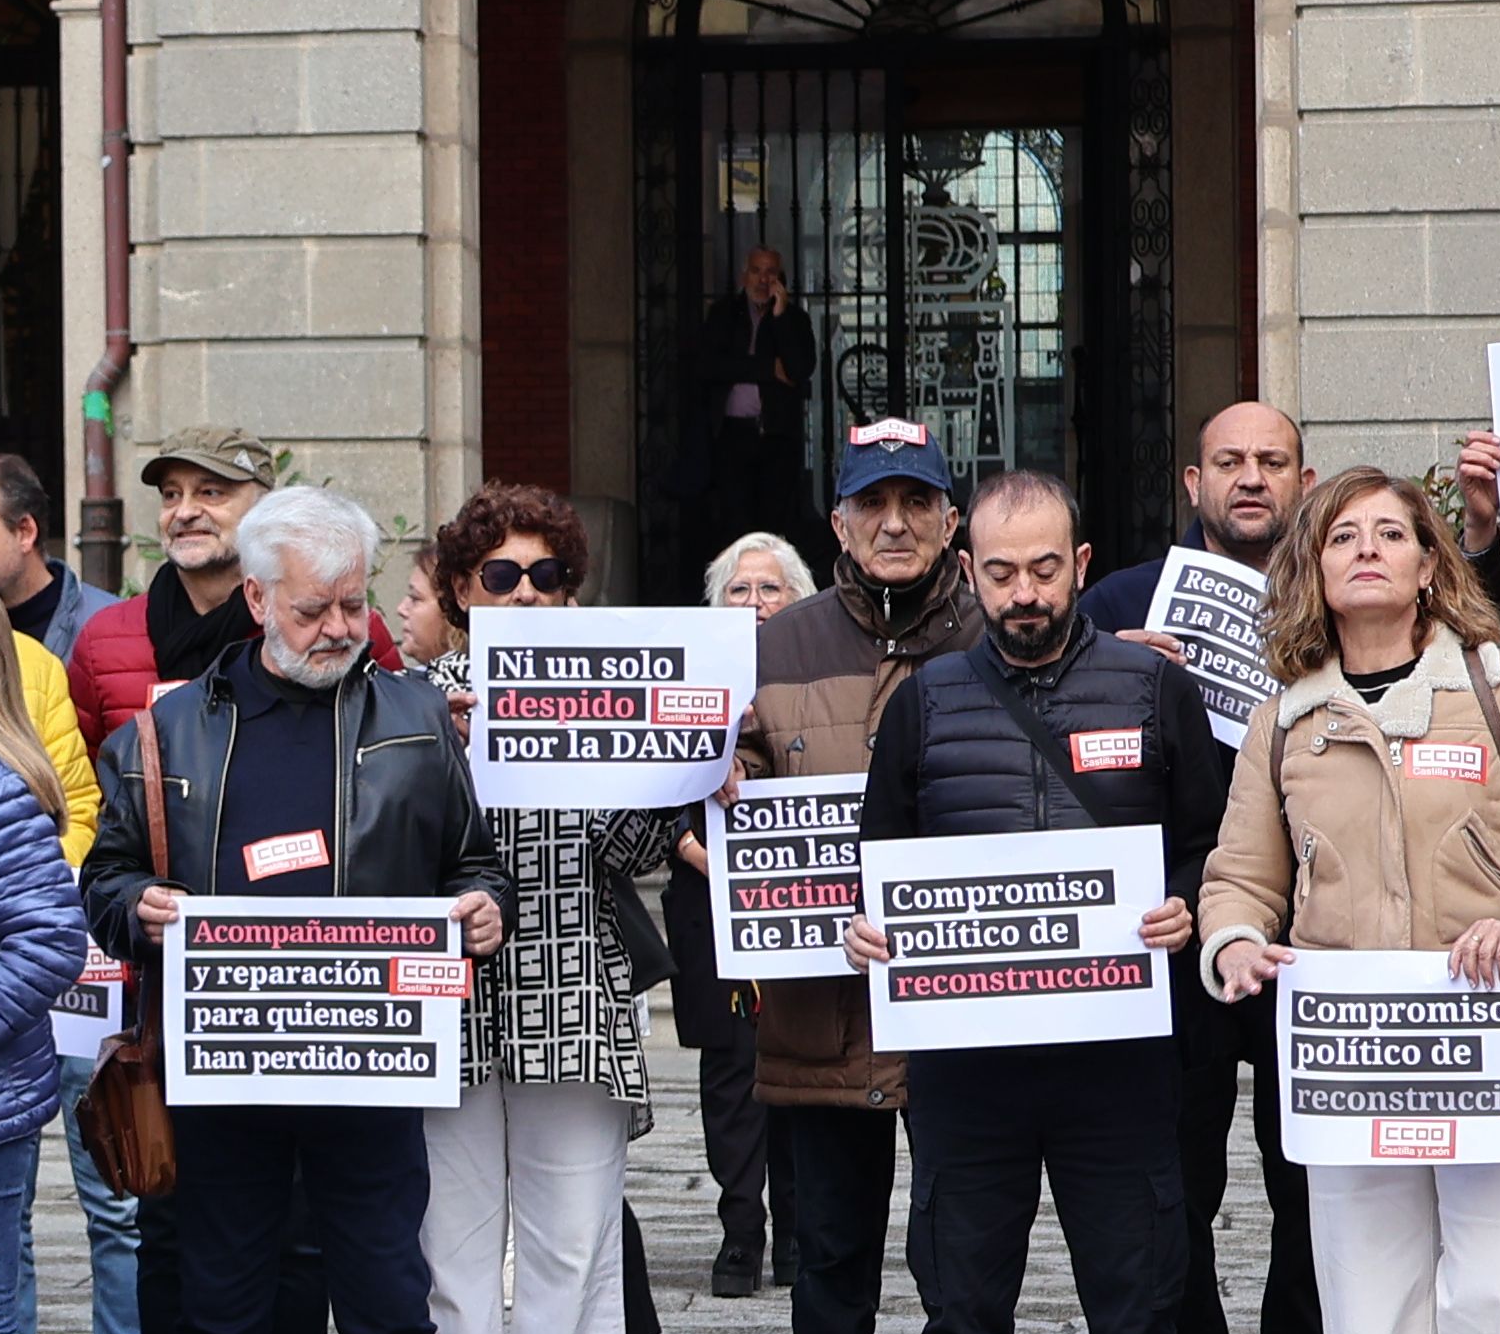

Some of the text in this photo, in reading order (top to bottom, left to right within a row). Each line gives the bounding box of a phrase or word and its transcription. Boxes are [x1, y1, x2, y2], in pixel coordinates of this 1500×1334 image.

[1171, 606, 1185, 622] a
[1188, 604, 1213, 627] la
[496, 649, 674, 679] Ni un solo
[1198, 648, 1286, 695] person
[496, 689, 635, 725] despido
[663, 695, 718, 708] CCOO
[657, 713, 724, 725] Castilla y León
[496, 730, 717, 763] por la DANA
[1084, 738, 1140, 753] CCOO
[1418, 750, 1476, 764] CCOO
[1081, 757, 1116, 768] Castilla
[1117, 757, 1124, 766] y
[1412, 767, 1482, 780] Castilla y León
[733, 795, 865, 831] Solidar
[258, 839, 313, 860] CCOO
[735, 838, 856, 870] con las
[892, 873, 1104, 914] Compromiso
[192, 919, 436, 949] Acompañamiento
[740, 921, 781, 949] de
[790, 919, 824, 947] la
[893, 917, 1069, 959] político de
[93, 971, 100, 981] y
[192, 960, 381, 992] y reparación
[403, 965, 460, 979] CCOO
[897, 959, 1143, 997] reconstrucción
[397, 983, 466, 995] Castilla y León
[192, 1002, 413, 1032] para quienes lo
[192, 1045, 430, 1075] han perdido todo
[1297, 1036, 1472, 1070] político de
[1386, 1127, 1444, 1141] CCOO
[1379, 1145, 1450, 1158] Castilla y León
